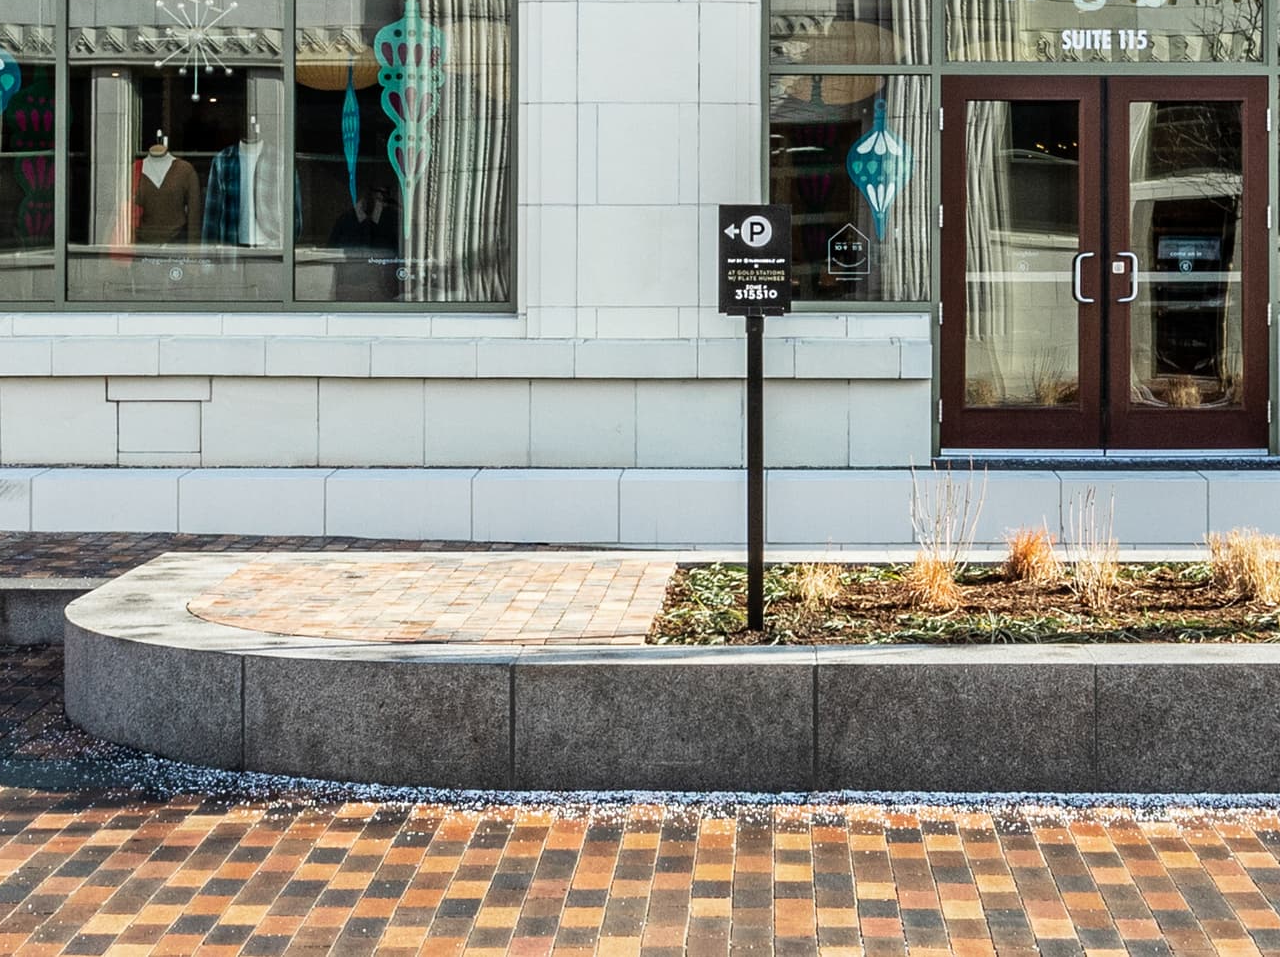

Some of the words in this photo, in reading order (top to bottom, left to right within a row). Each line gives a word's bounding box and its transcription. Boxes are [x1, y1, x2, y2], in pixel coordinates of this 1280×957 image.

[1061, 29, 1112, 50] SUITE
[1118, 29, 1148, 50] 115
[749, 221, 765, 242] P
[735, 289, 778, 300] 315510
